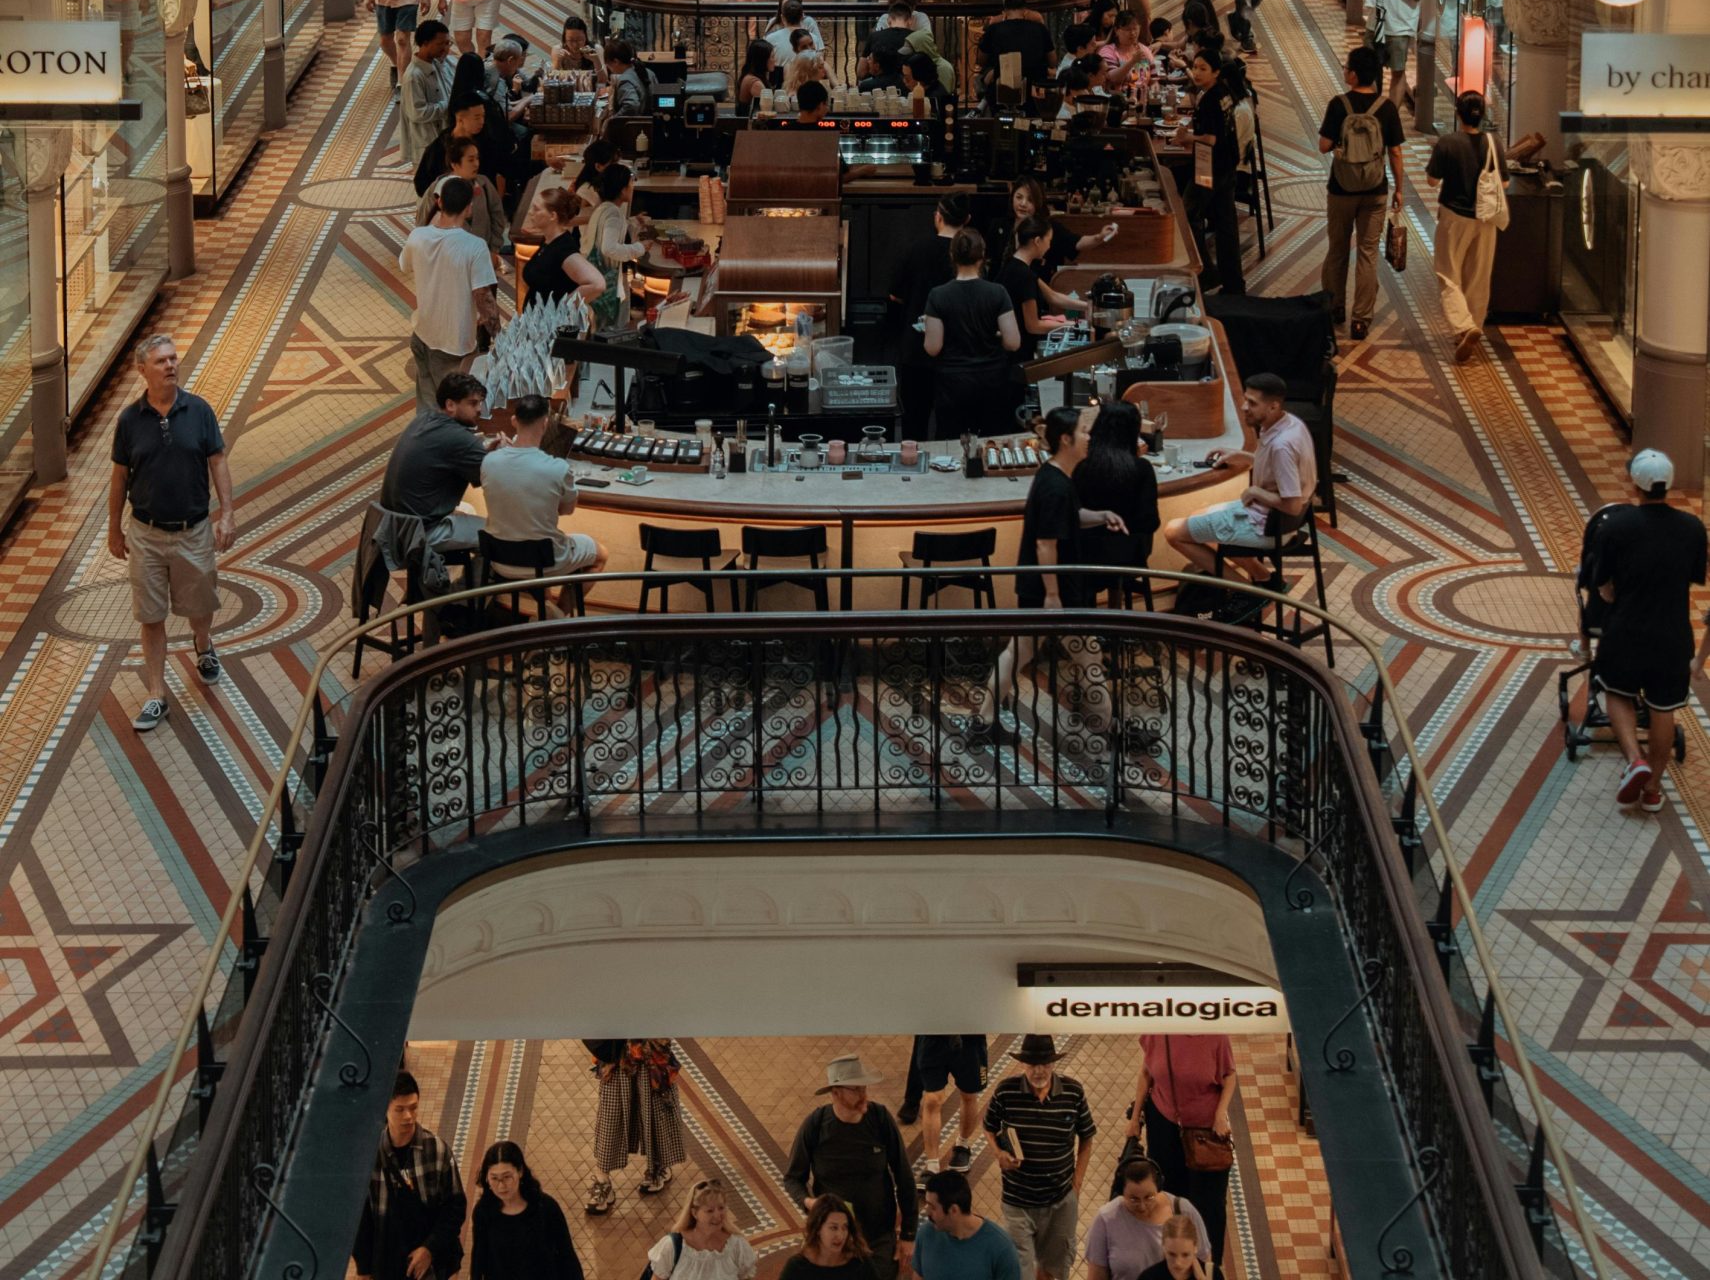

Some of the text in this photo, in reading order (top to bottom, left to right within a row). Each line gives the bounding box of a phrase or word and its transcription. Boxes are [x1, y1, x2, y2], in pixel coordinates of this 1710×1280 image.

[0, 50, 107, 74] OTON
[1607, 62, 1642, 95] by
[1046, 998, 1278, 1020] dermalogica
